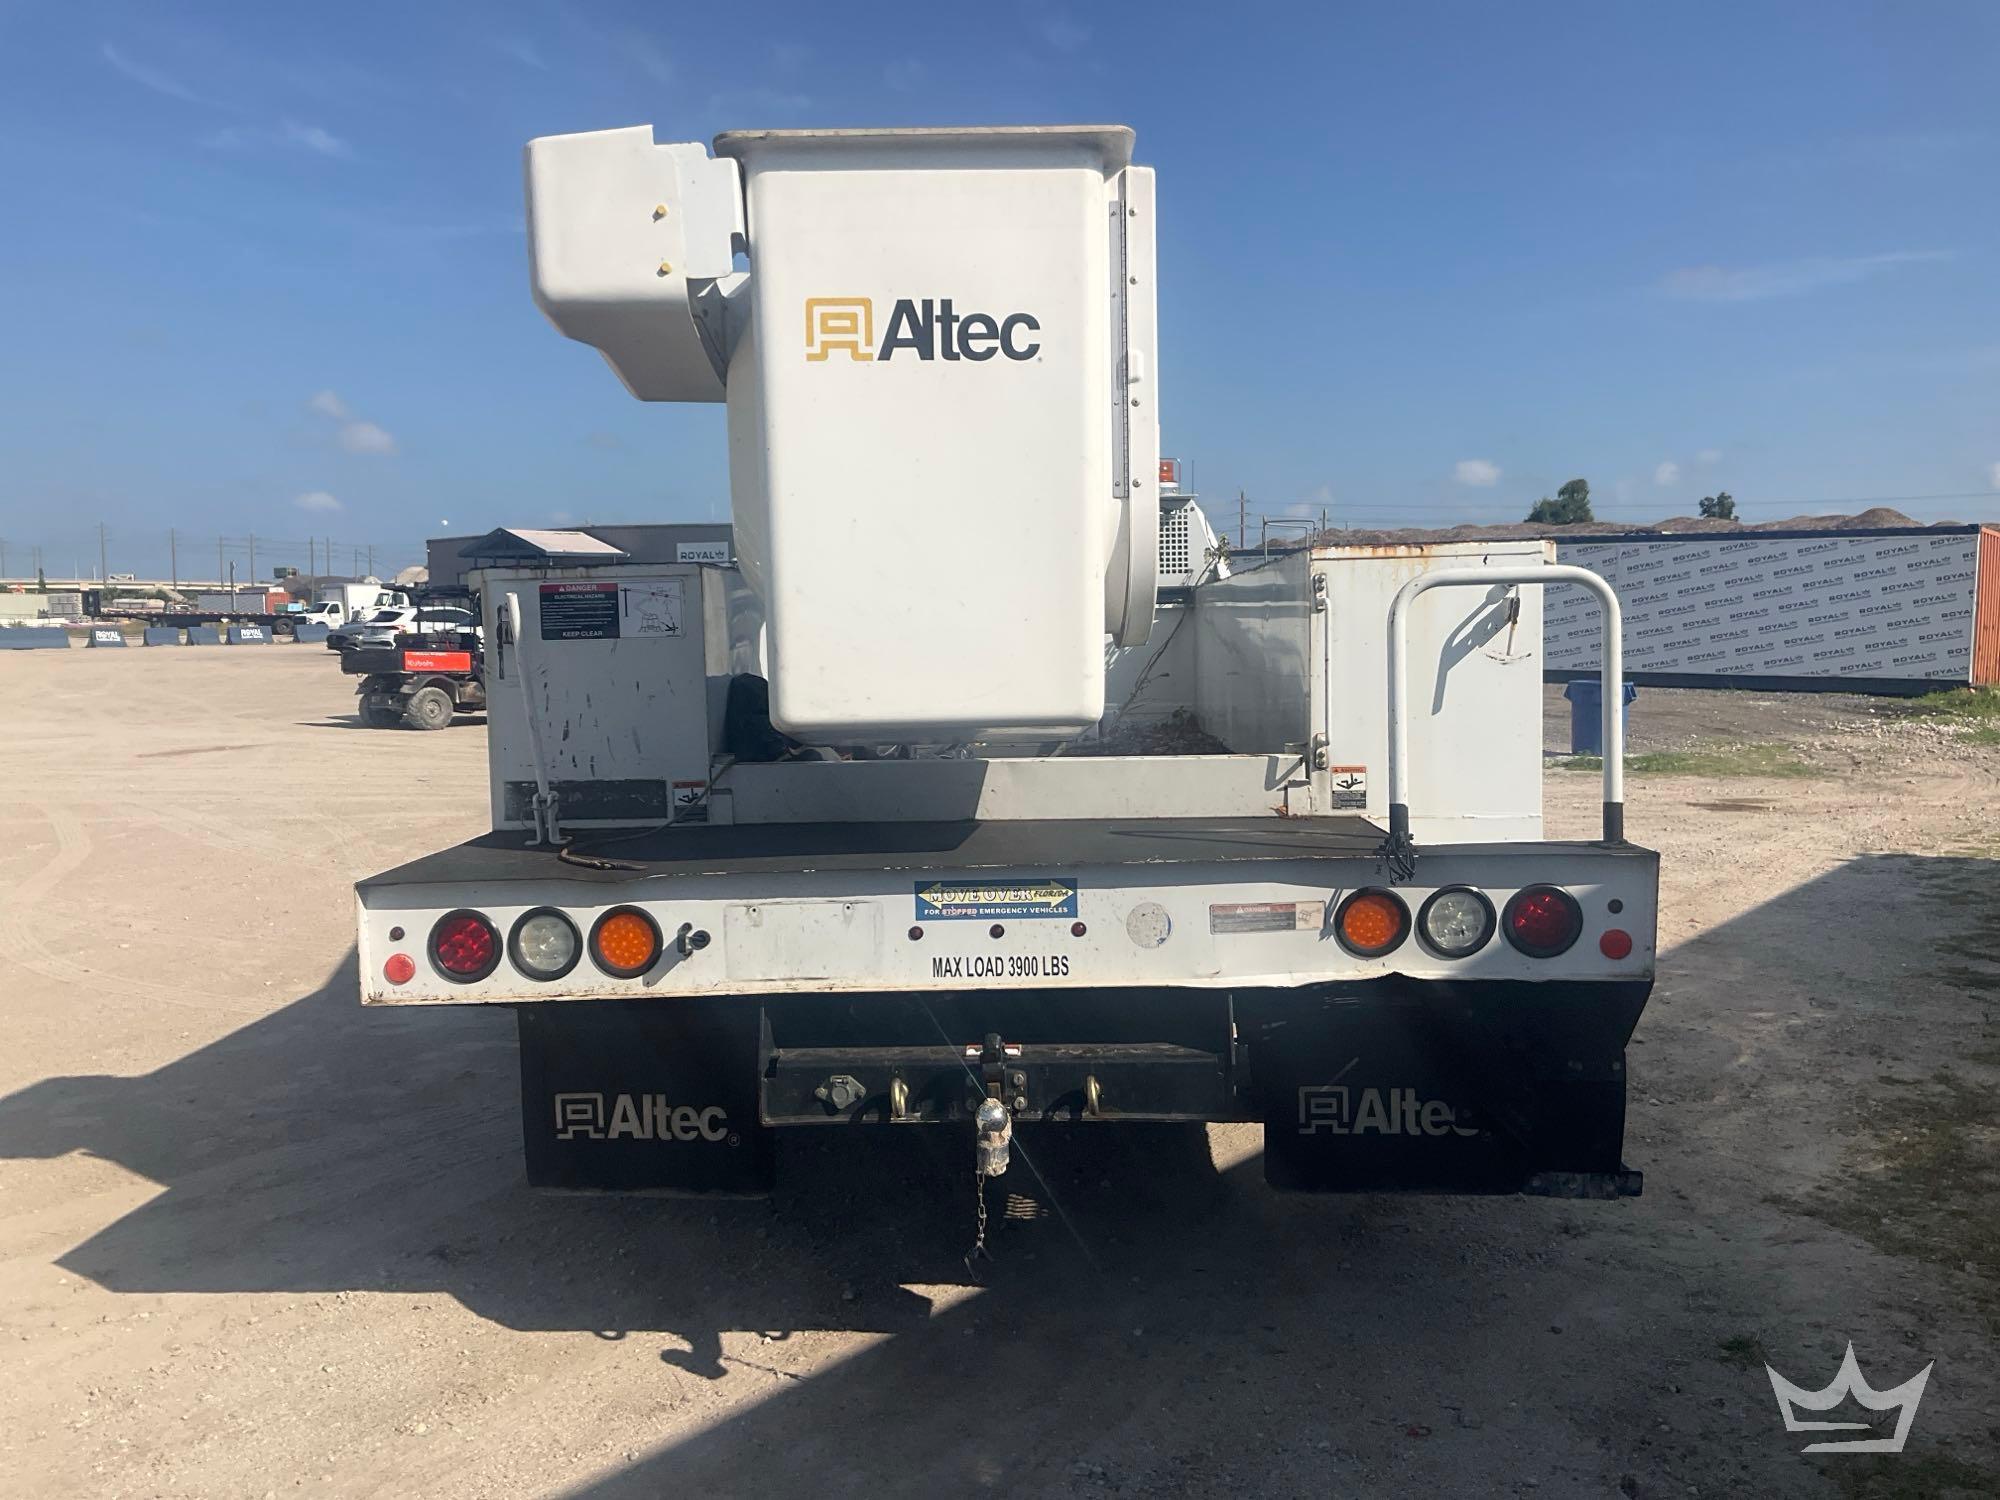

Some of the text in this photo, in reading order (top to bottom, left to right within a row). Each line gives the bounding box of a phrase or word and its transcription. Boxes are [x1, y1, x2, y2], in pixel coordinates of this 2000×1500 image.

[878, 298, 1041, 361] Altec
[1720, 543, 1750, 551] ROYAL
[1797, 543, 1829, 554] ROYAL
[1876, 545, 1909, 556] ROYAL
[680, 551, 715, 560] ROYAL
[1673, 552, 1701, 561] ROYAL
[1748, 554, 1779, 563] ROYAL
[1824, 556, 1856, 566] ROYAL
[1907, 558, 1940, 568] ROYAL
[1627, 562, 1653, 571] ROYAL
[1700, 563, 1729, 572] ROYAL
[1773, 566, 1805, 576] ROYAL
[1653, 574, 1681, 582] ROYAL
[1854, 569, 1887, 578] ROYAL
[1936, 571, 1970, 581] ROYAL
[1724, 576, 1755, 585] ROYAL
[1803, 578, 1834, 588] ROYAL
[1544, 583, 1564, 592] OYAL
[1677, 585, 1707, 594] ROYAL
[1881, 581, 1915, 591] ROYAL
[1753, 588, 1783, 597] ROYAL
[1829, 591, 1861, 601] ROYAL
[1563, 596, 1588, 605] ROYAL
[1632, 595, 1659, 603] ROYAL
[1704, 597, 1734, 606] ROYAL
[1913, 594, 1947, 604] ROYAL
[1779, 601, 1810, 610] ROYAL
[1859, 603, 1892, 613] ROYAL
[1658, 607, 1685, 615] ROYAL
[1730, 610, 1760, 619] ROYAL
[1941, 609, 1970, 618] ROYA
[1808, 612, 1839, 622] ROYAL
[1683, 619, 1712, 627] ROYAL
[1758, 621, 1789, 631] ROYAL
[1887, 617, 1921, 627] ROYAL
[241, 629, 262, 637] ROYAL
[1568, 629, 1594, 637] ROYAL
[1636, 627, 1664, 636] ROYAL
[1710, 631, 1740, 640] ROYAL
[1834, 626, 1867, 636] ROYAL
[1919, 631, 1954, 640] ROYAL
[1664, 640, 1692, 648] ROYAL
[1784, 635, 1815, 645] ROYAL
[1865, 640, 1898, 649] ROYAL
[1735, 643, 1766, 653] ROYAL
[1813, 648, 1844, 657] ROYAL
[1547, 649, 1574, 657] ROYAL
[1687, 651, 1716, 661] ROYAL
[1763, 657, 1795, 665] ROYAL
[1893, 654, 1927, 663] ROYAL
[1572, 660, 1600, 668] ROYAL
[1642, 661, 1670, 669] ROYAL
[1715, 664, 1745, 673] ROYAL
[1840, 662, 1872, 671] ROYAL
[1925, 667, 1960, 677] ROYAL
[929, 887, 1070, 902] MOVE OVER FLORIDA
[1030, 906, 1068, 914] VEHICLES
[932, 955, 1069, 978] MAX LOAD 3900 LBS
[607, 1093, 728, 1142] Altec
